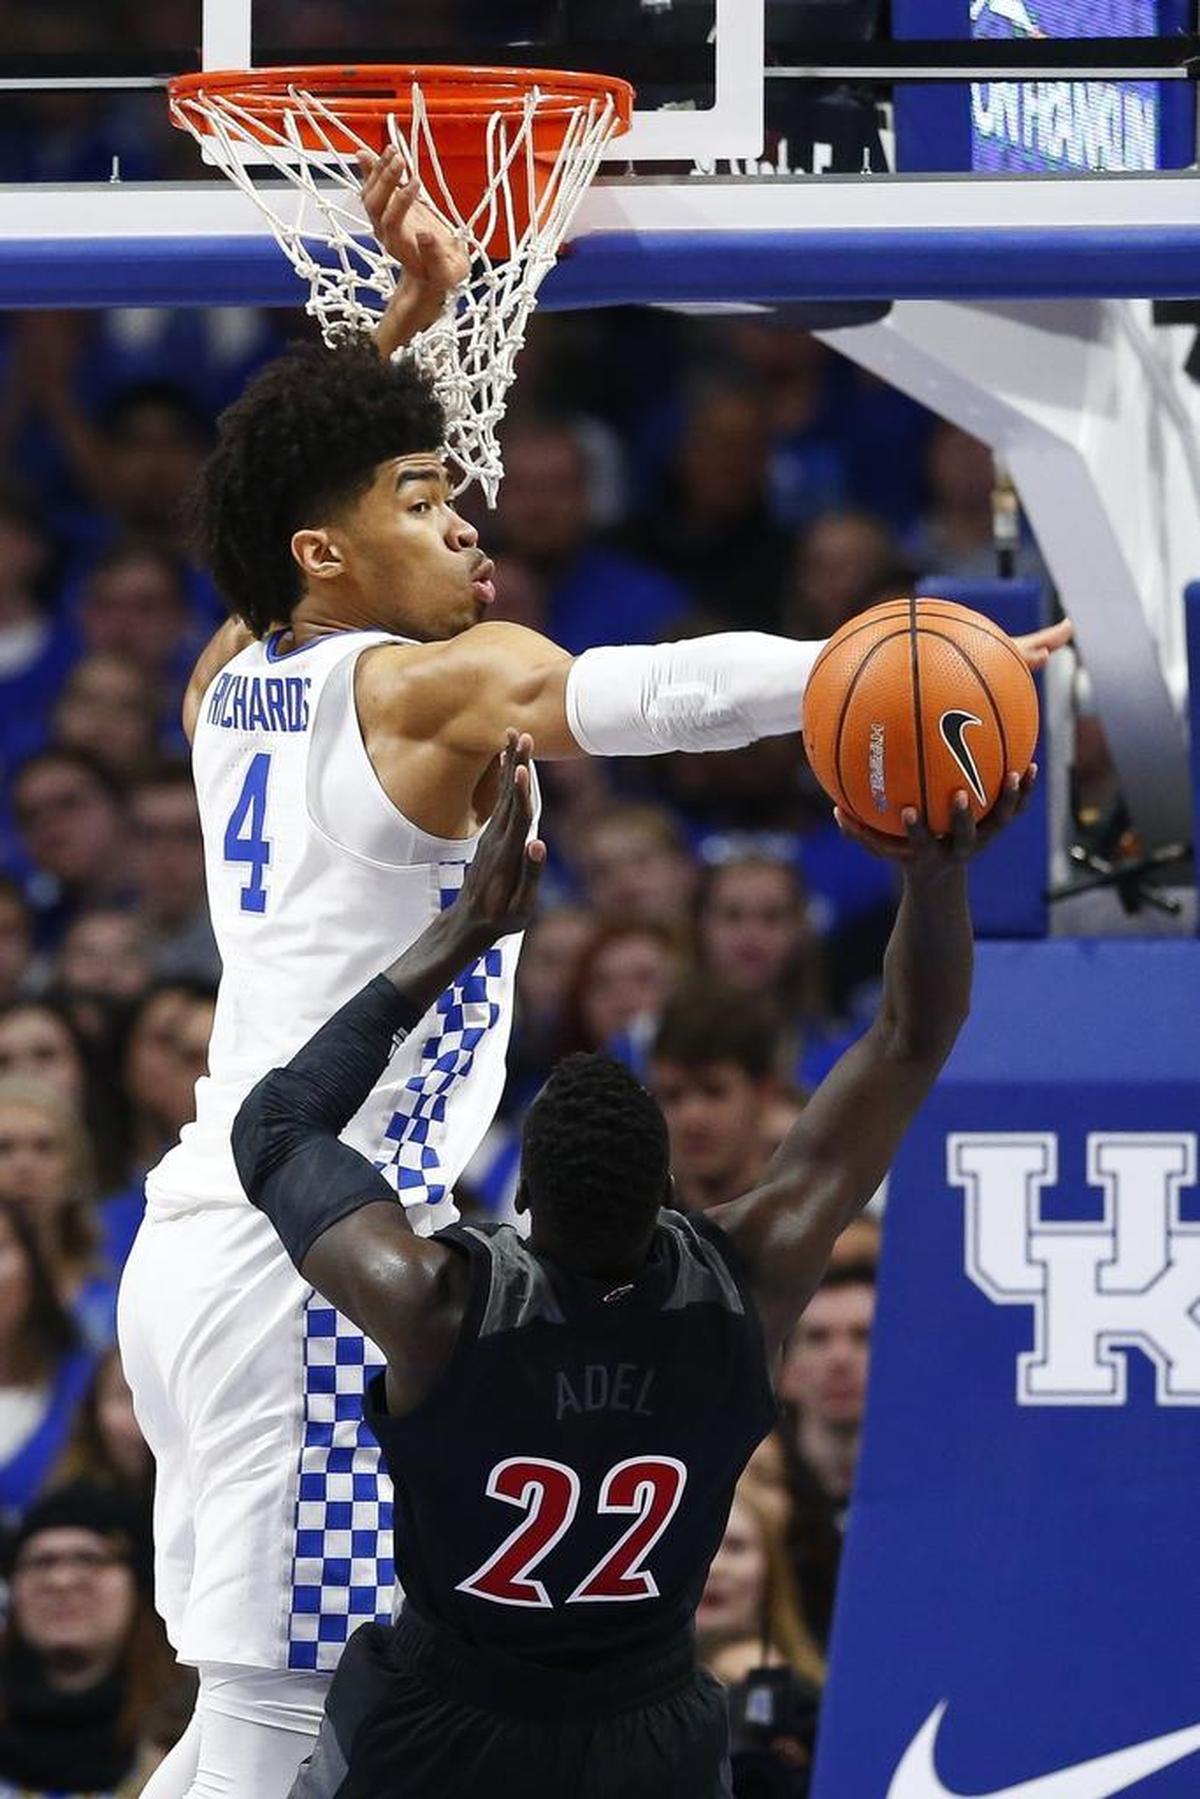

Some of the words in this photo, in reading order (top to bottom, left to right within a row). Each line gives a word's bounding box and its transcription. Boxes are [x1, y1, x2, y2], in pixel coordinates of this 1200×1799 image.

[223, 752, 272, 913] 4
[947, 1132, 1200, 1406] UK
[555, 1363, 656, 1420] ADEL
[454, 1454, 688, 1609] 22
